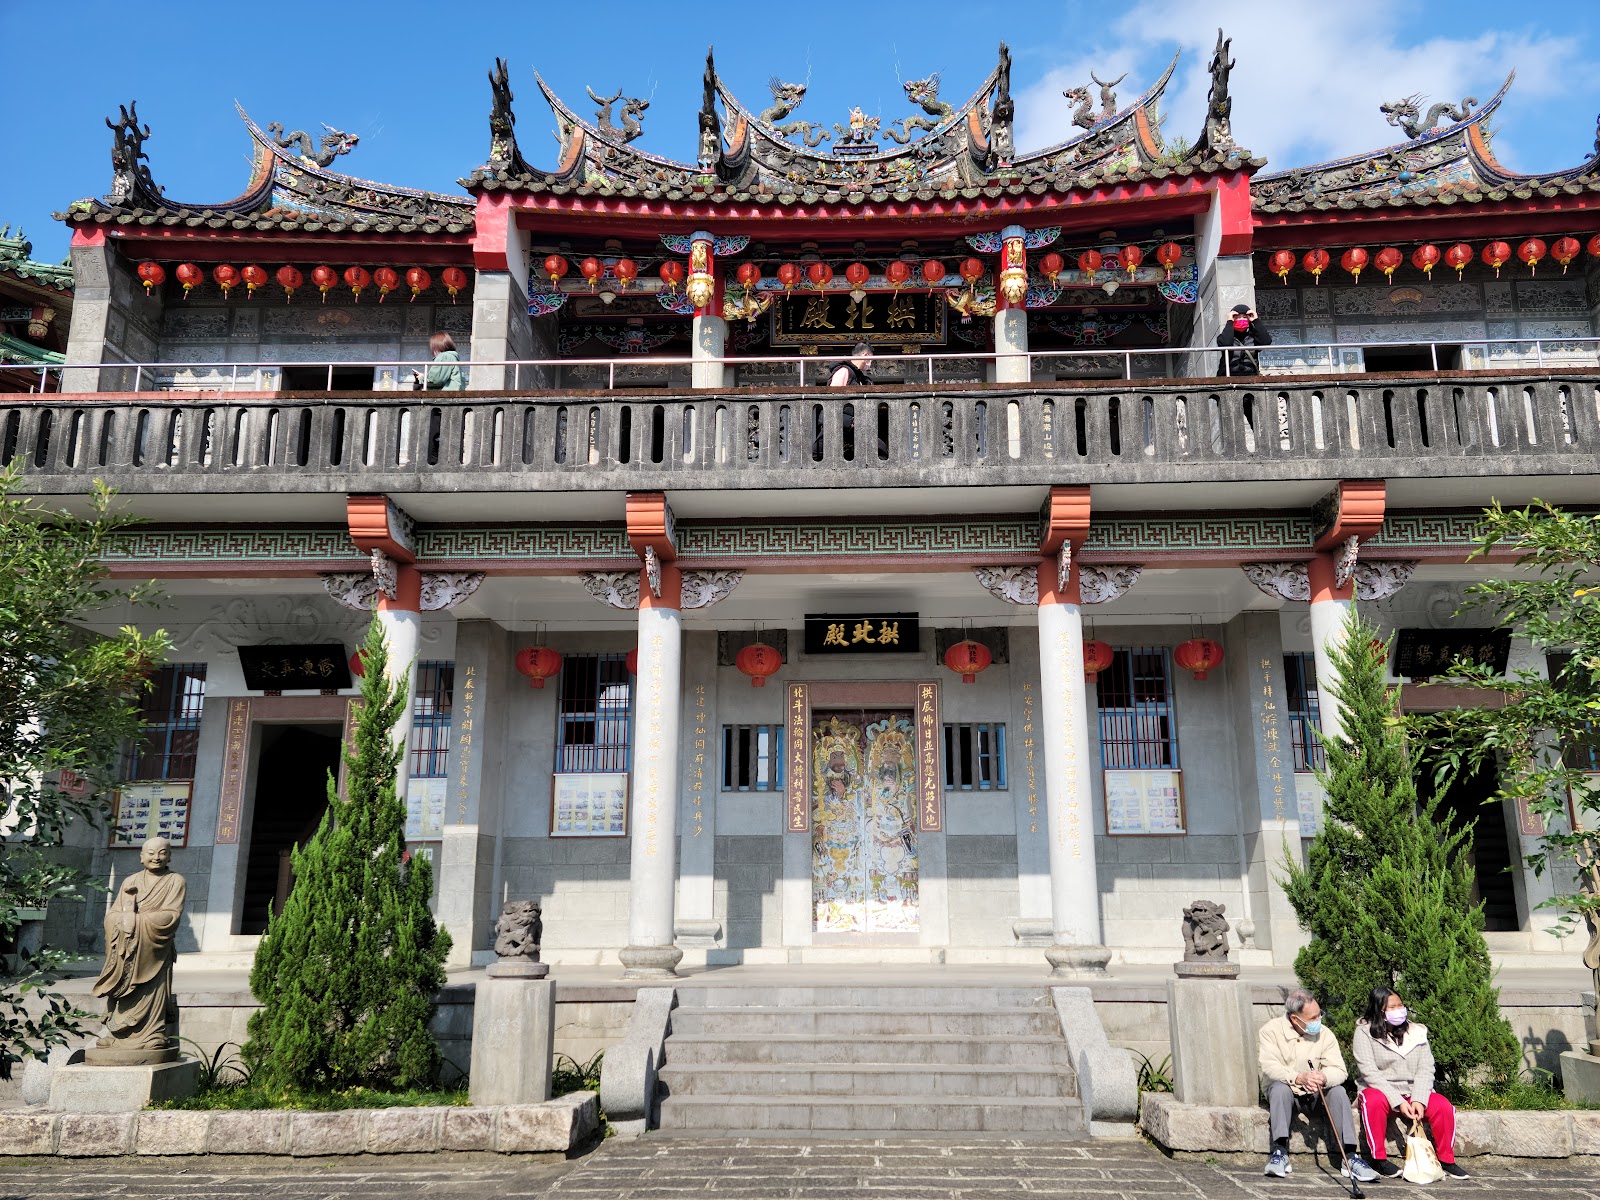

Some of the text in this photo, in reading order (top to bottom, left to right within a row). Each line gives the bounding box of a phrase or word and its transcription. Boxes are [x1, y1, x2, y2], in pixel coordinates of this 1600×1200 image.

[799, 295, 916, 329] 拱北殿
[823, 619, 900, 647] 拱北殿
[756, 647, 765, 666] 拱北殿
[967, 644, 977, 663] 拱北殿
